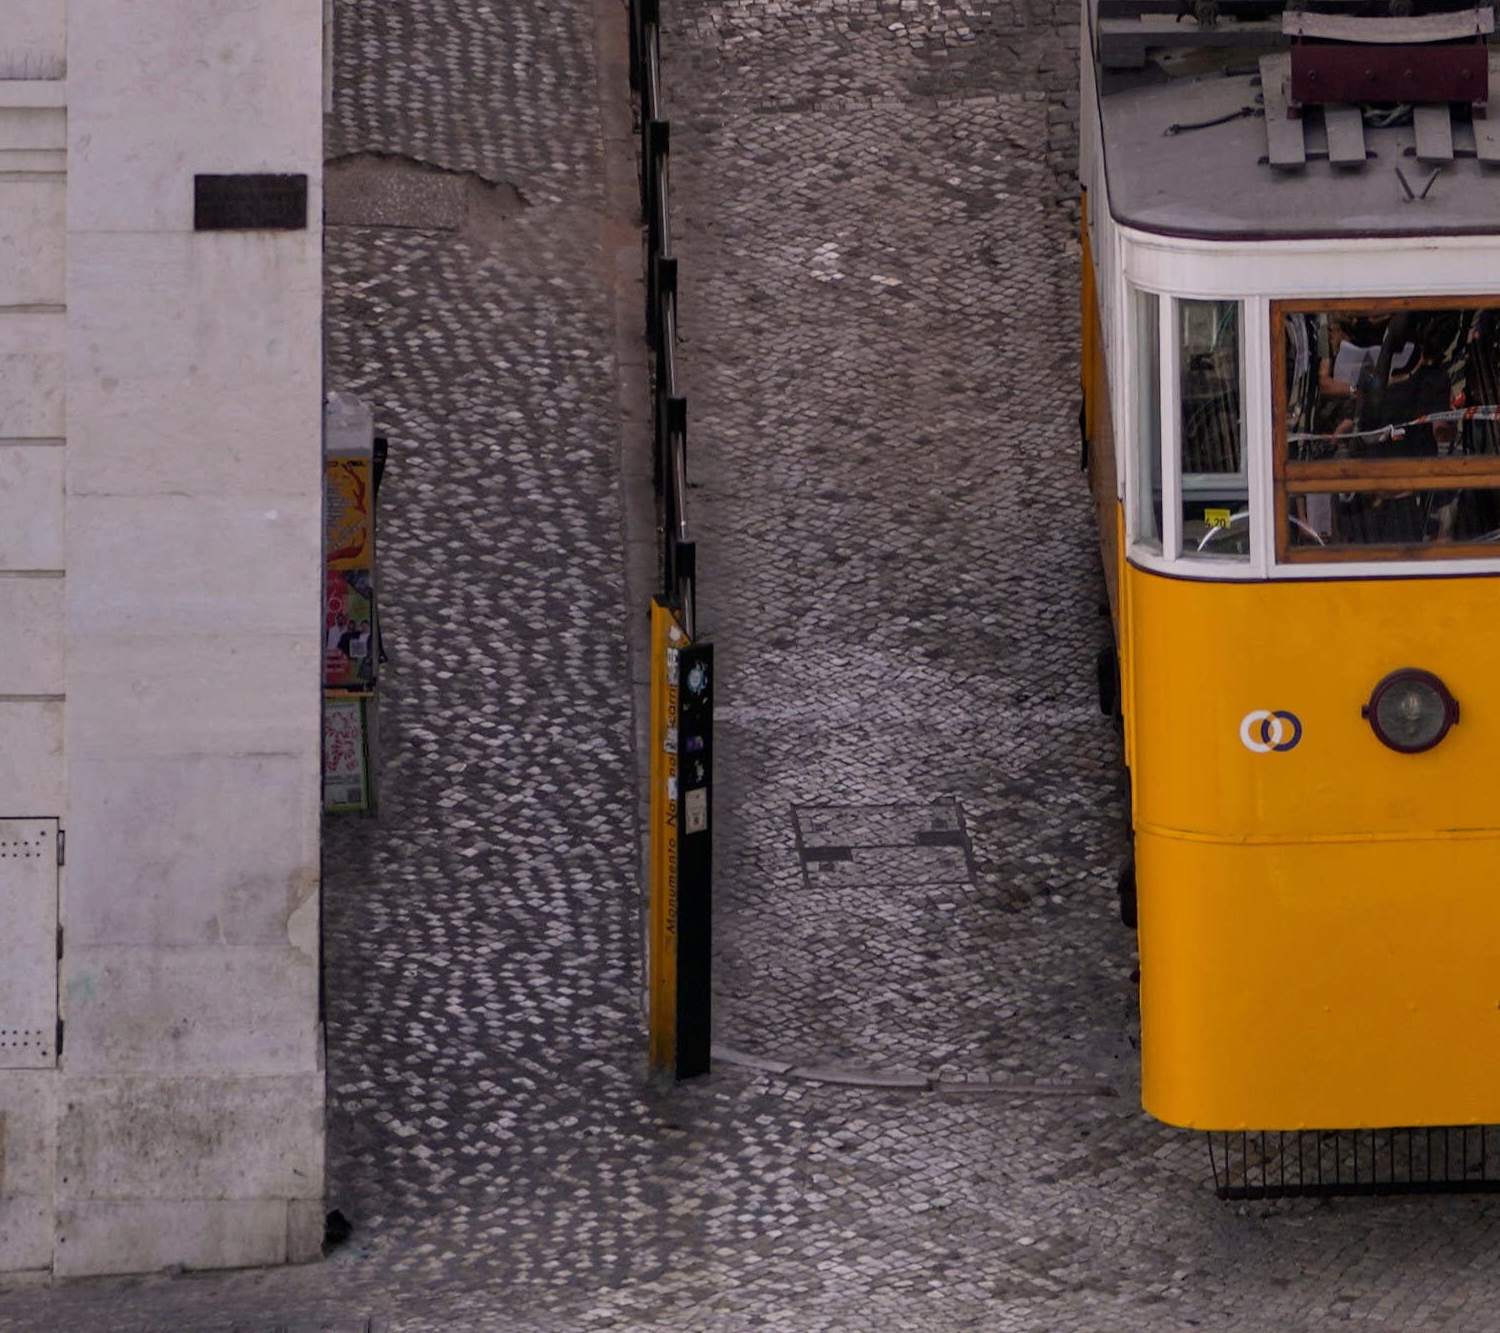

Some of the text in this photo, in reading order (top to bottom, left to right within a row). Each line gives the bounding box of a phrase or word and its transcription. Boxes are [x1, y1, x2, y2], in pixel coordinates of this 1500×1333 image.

[664, 684, 678, 935] Monumento Nanal carri
